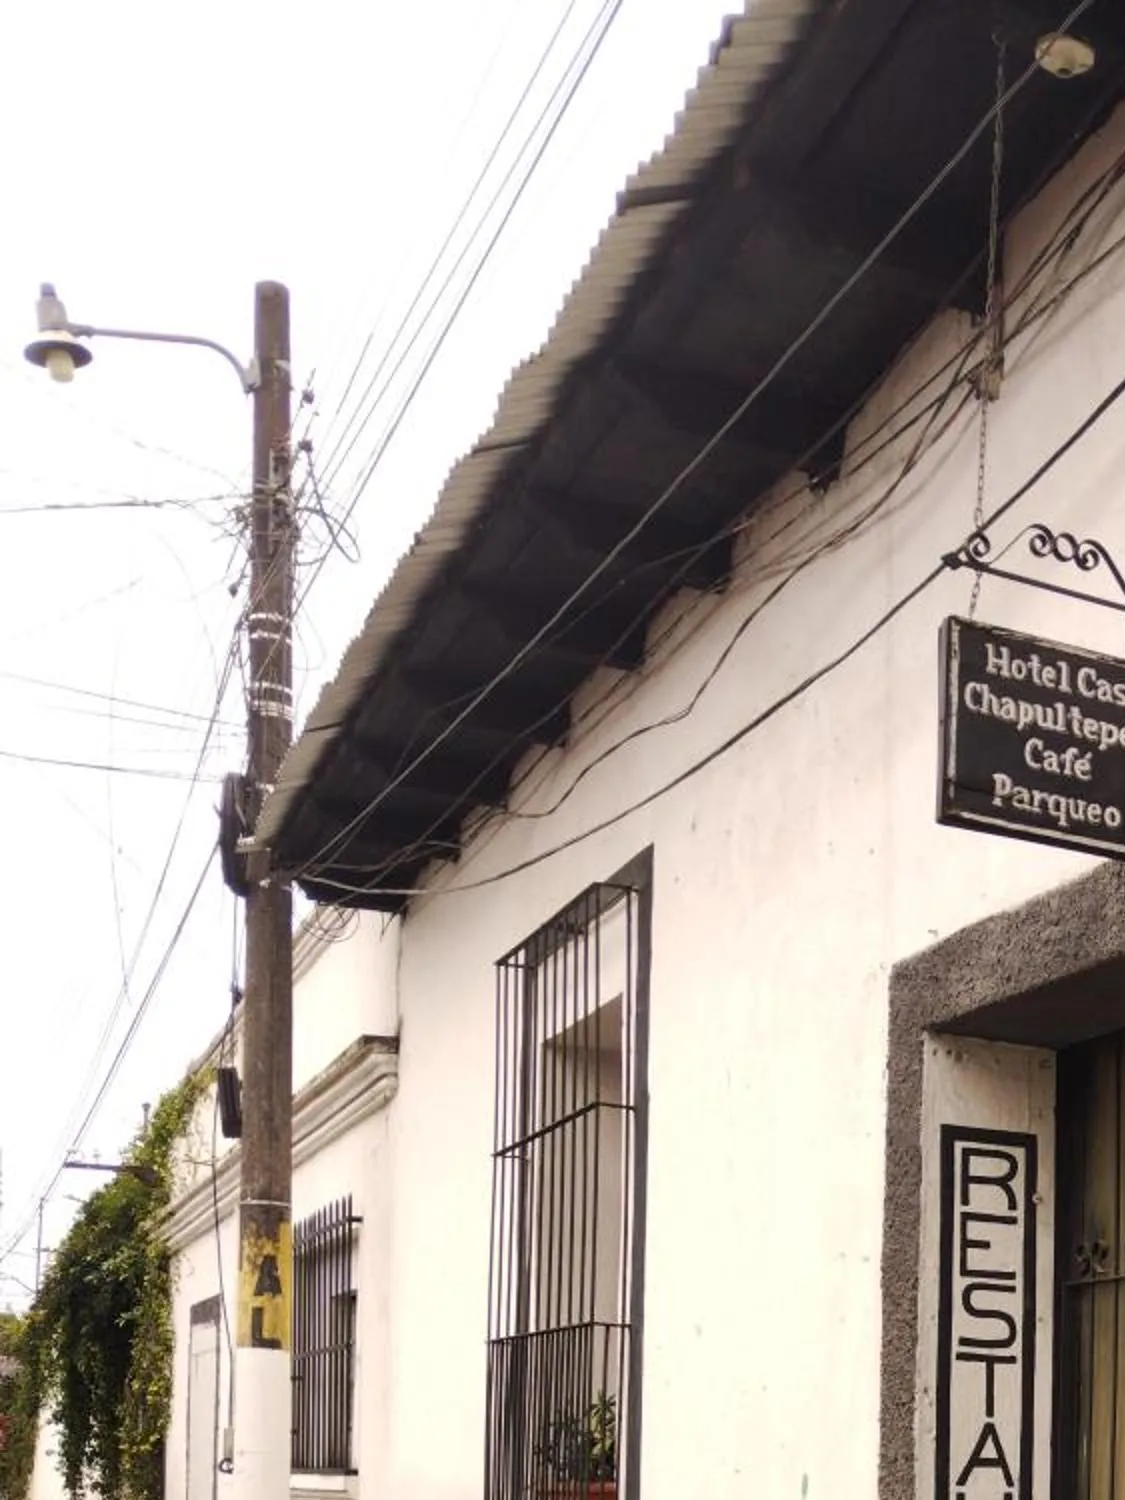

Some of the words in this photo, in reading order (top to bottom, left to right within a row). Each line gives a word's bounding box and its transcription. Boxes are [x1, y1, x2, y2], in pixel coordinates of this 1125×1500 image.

[984, 643, 1073, 693] Hotel
[1024, 739, 1094, 780] Café
[991, 773, 1123, 827] Parqueo
